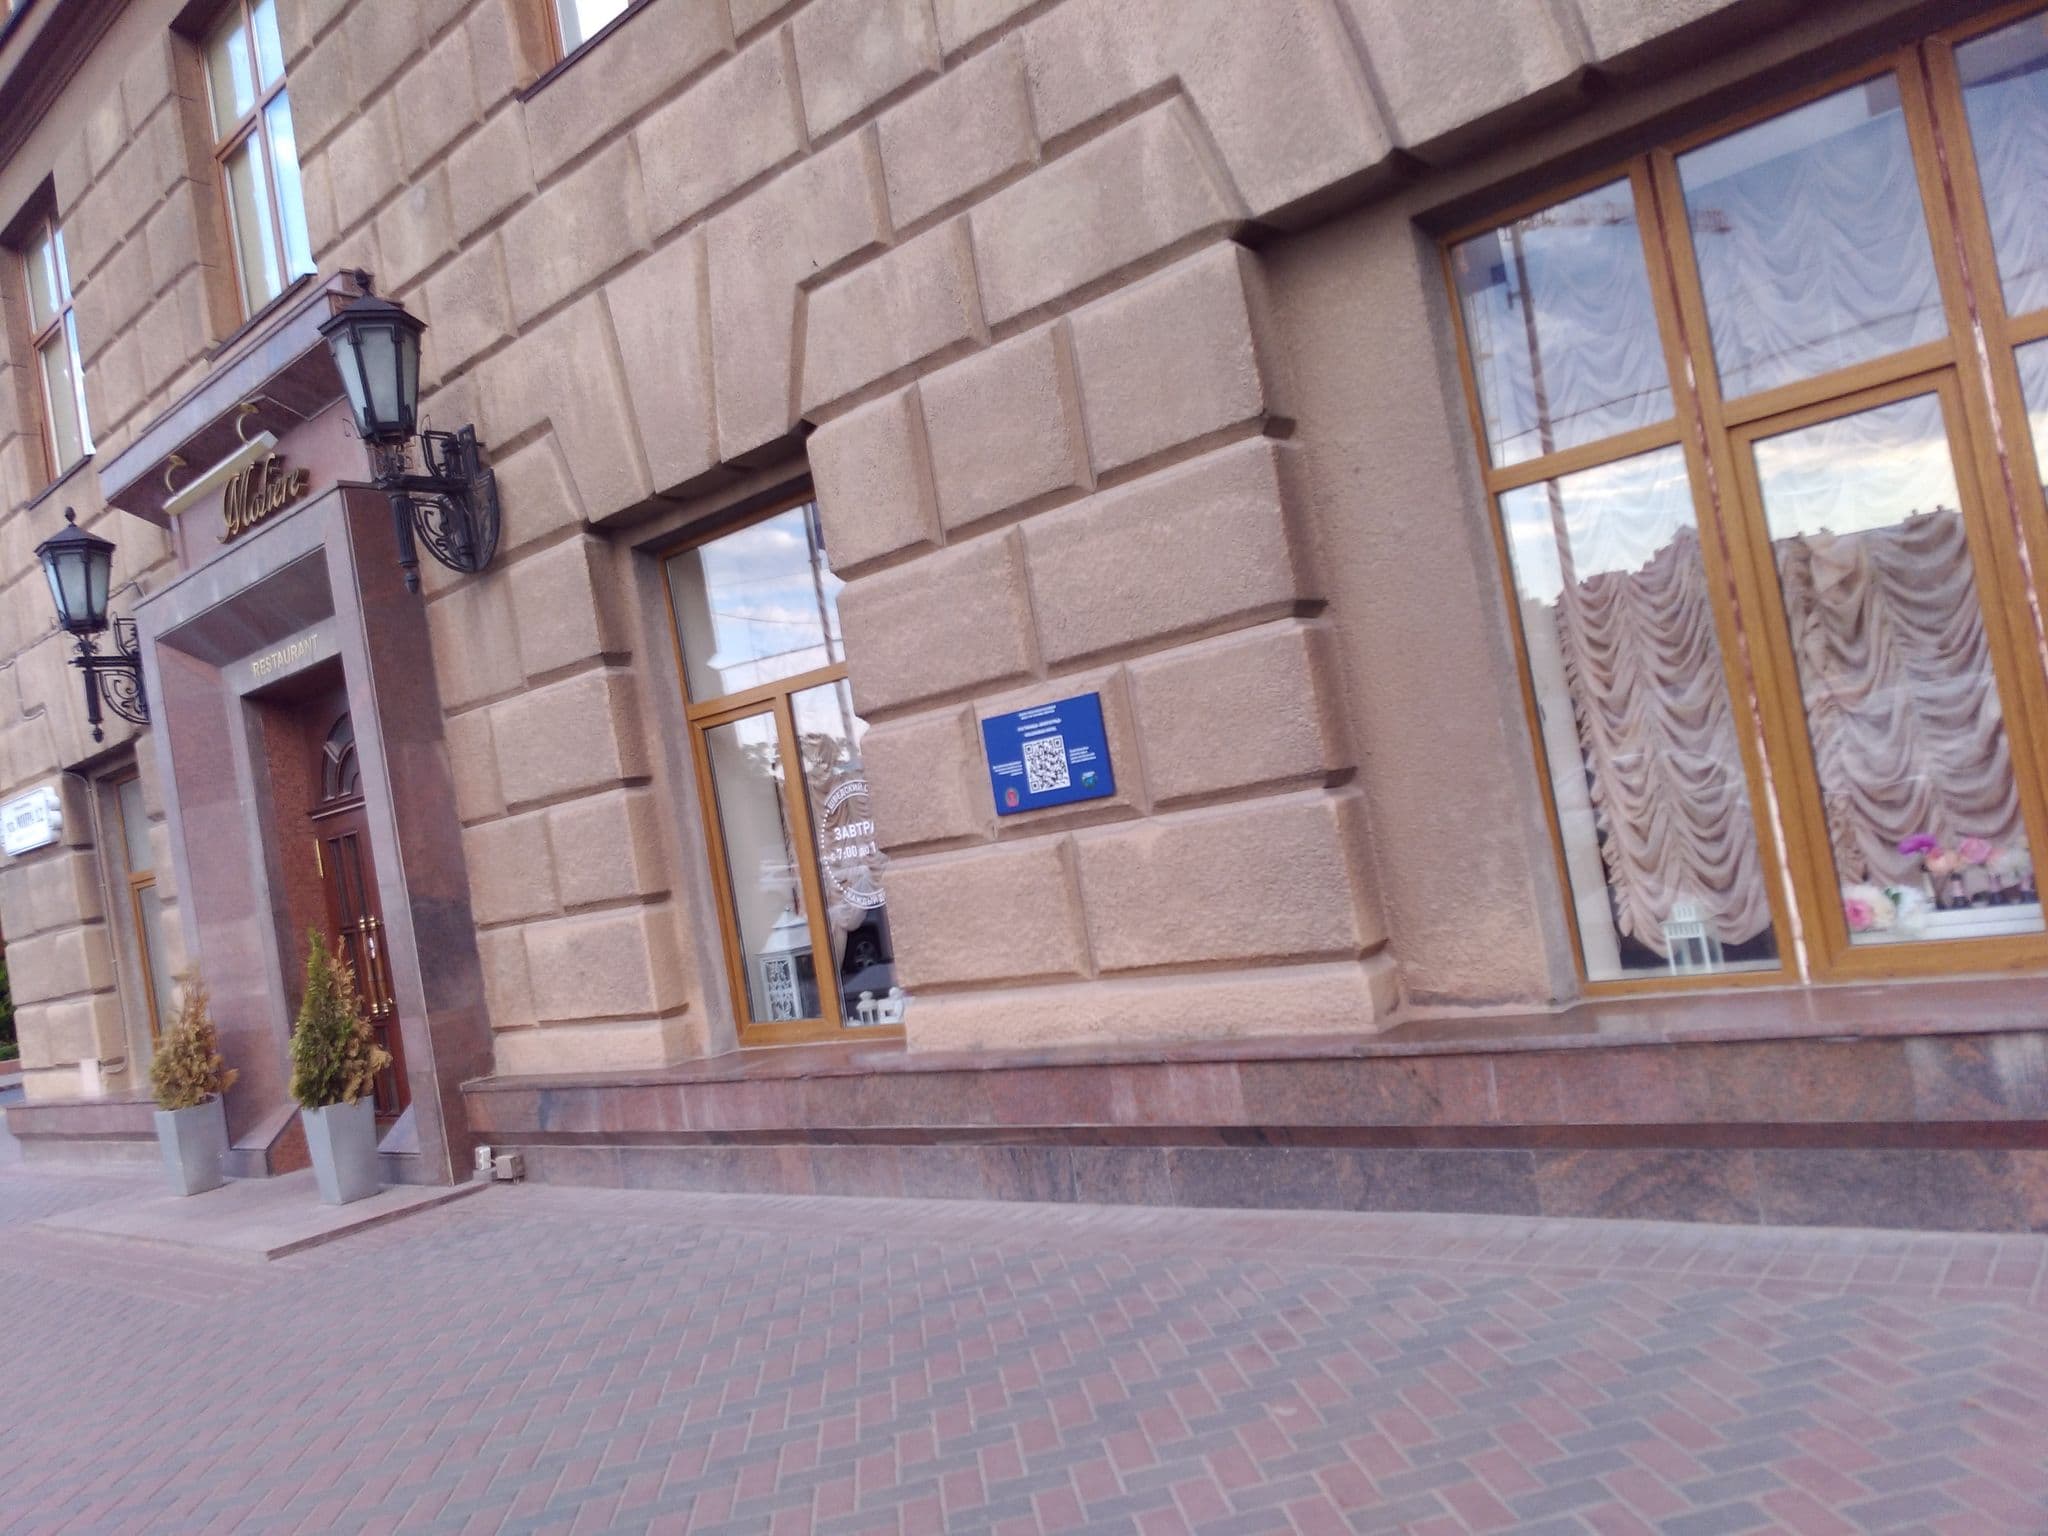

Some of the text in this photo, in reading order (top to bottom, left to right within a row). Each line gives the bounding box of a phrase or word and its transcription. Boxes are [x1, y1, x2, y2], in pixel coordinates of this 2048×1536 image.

[252, 633, 318, 677] RESTAURANT
[827, 782, 864, 809] ШВЕДСКИЙ
[836, 845, 858, 860] 7:00
